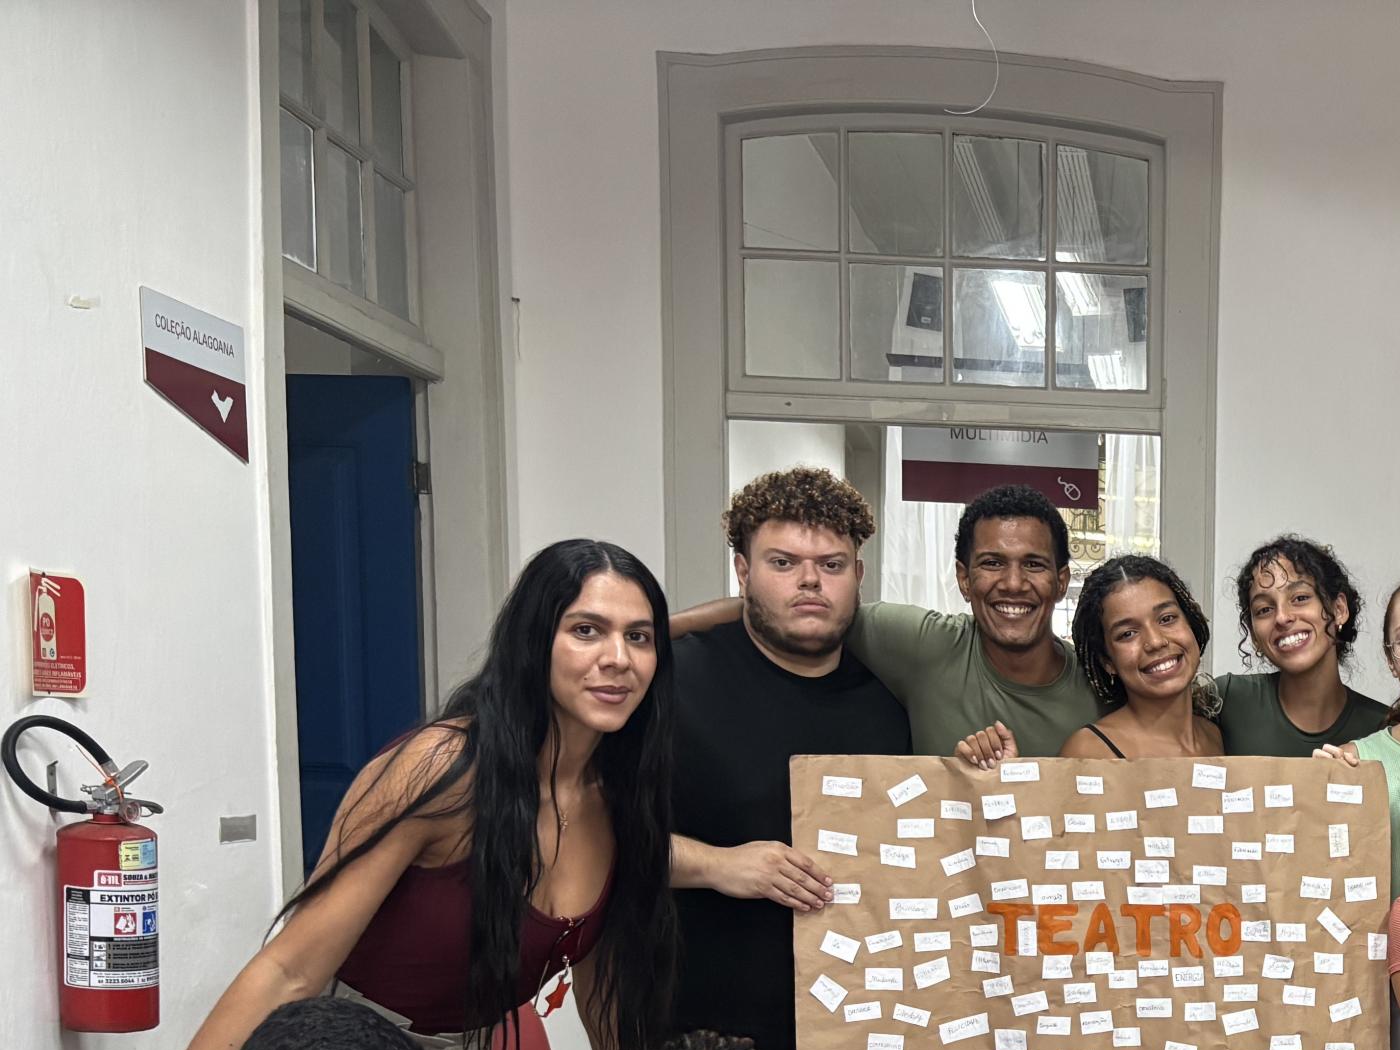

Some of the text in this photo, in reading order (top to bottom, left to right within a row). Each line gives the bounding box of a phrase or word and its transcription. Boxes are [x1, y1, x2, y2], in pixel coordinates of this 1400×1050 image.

[154, 312, 235, 359] COLEÇÃO ALAGOANA
[100, 893, 146, 903] EXTINTOR
[986, 902, 1242, 959] TEATRO
